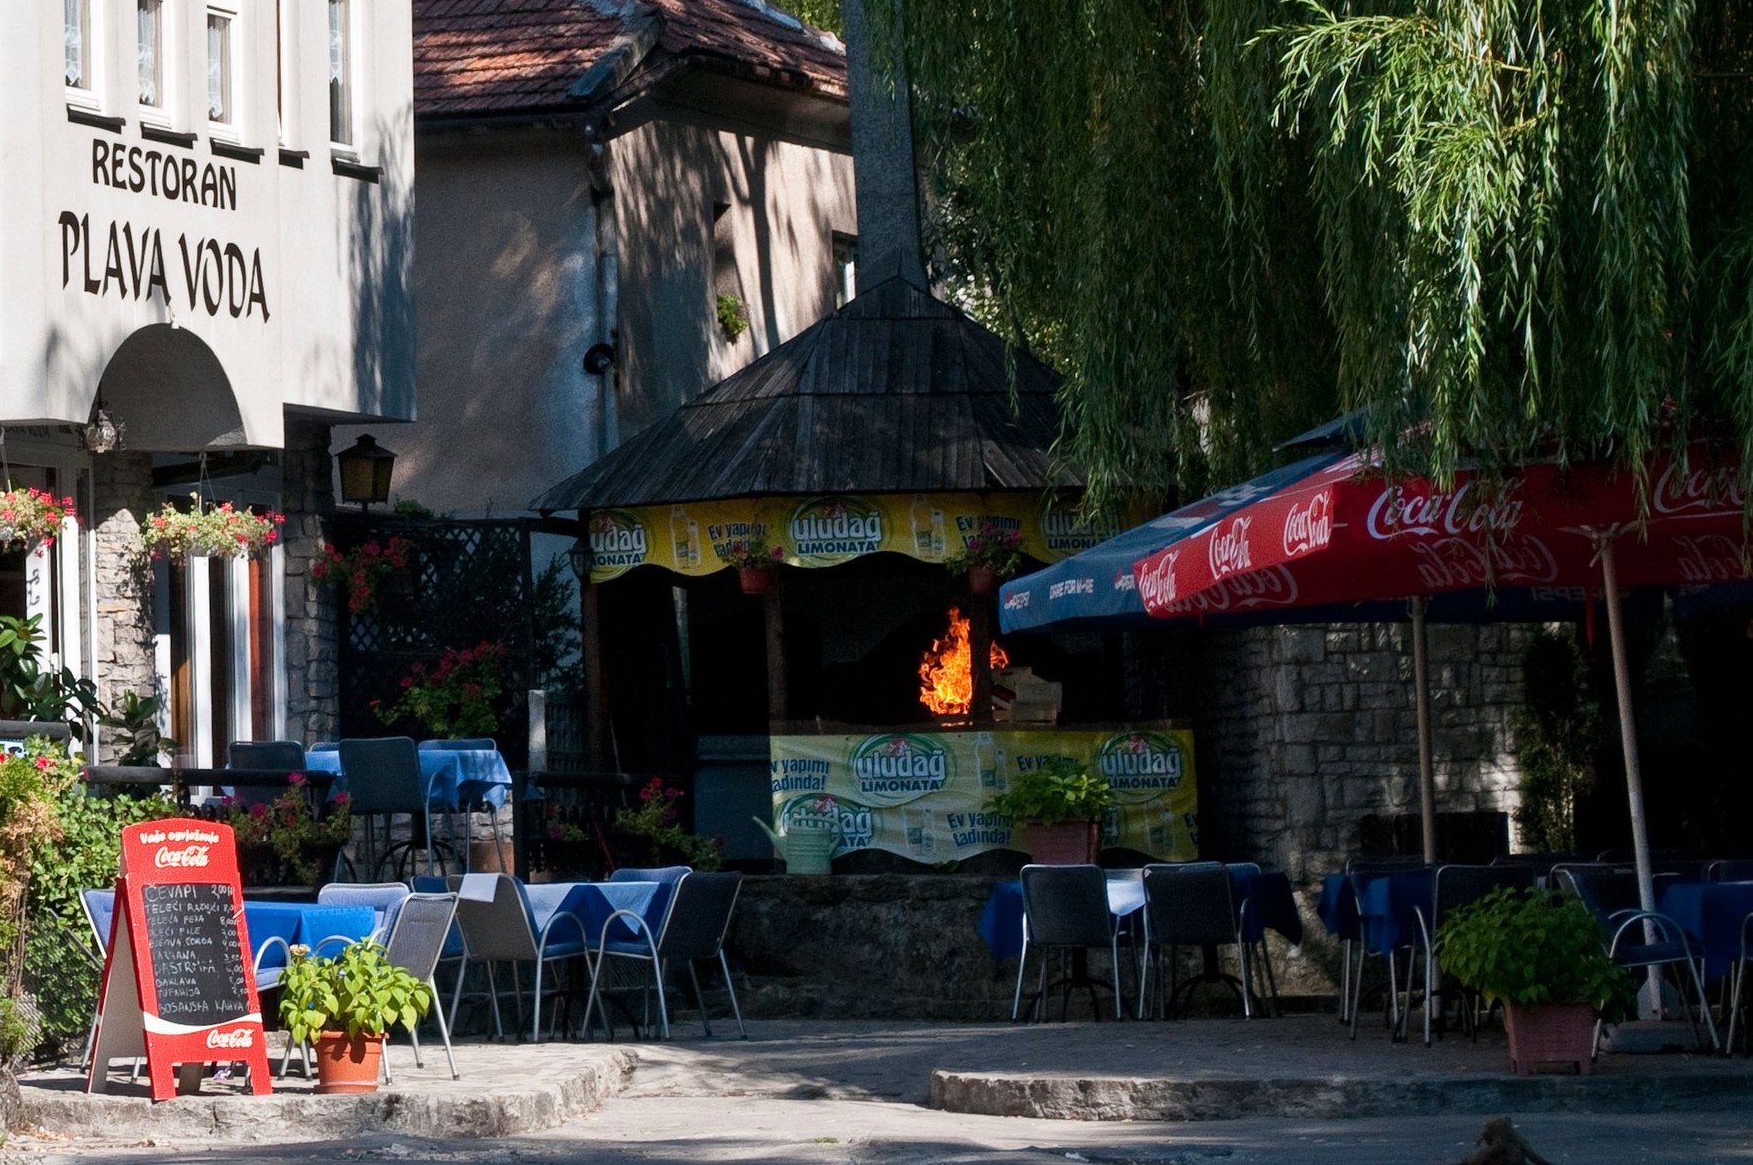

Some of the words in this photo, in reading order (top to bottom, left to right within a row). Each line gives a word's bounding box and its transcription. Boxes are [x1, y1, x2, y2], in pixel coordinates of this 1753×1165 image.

[93, 138, 236, 210] RESTORAN
[58, 211, 171, 306] PLAVA
[178, 232, 270, 323] VODA
[591, 523, 646, 553] udağ
[708, 525, 722, 540] Ev
[798, 541, 876, 554] LIMONATA
[591, 554, 640, 567] ONATA
[1017, 755, 1031, 771] Ev
[771, 775, 826, 792] adında!
[861, 780, 941, 792] LIMONATA
[1107, 777, 1177, 790] LIMONATA
[947, 813, 964, 829] Ev
[140, 830, 166, 844] Vaše
